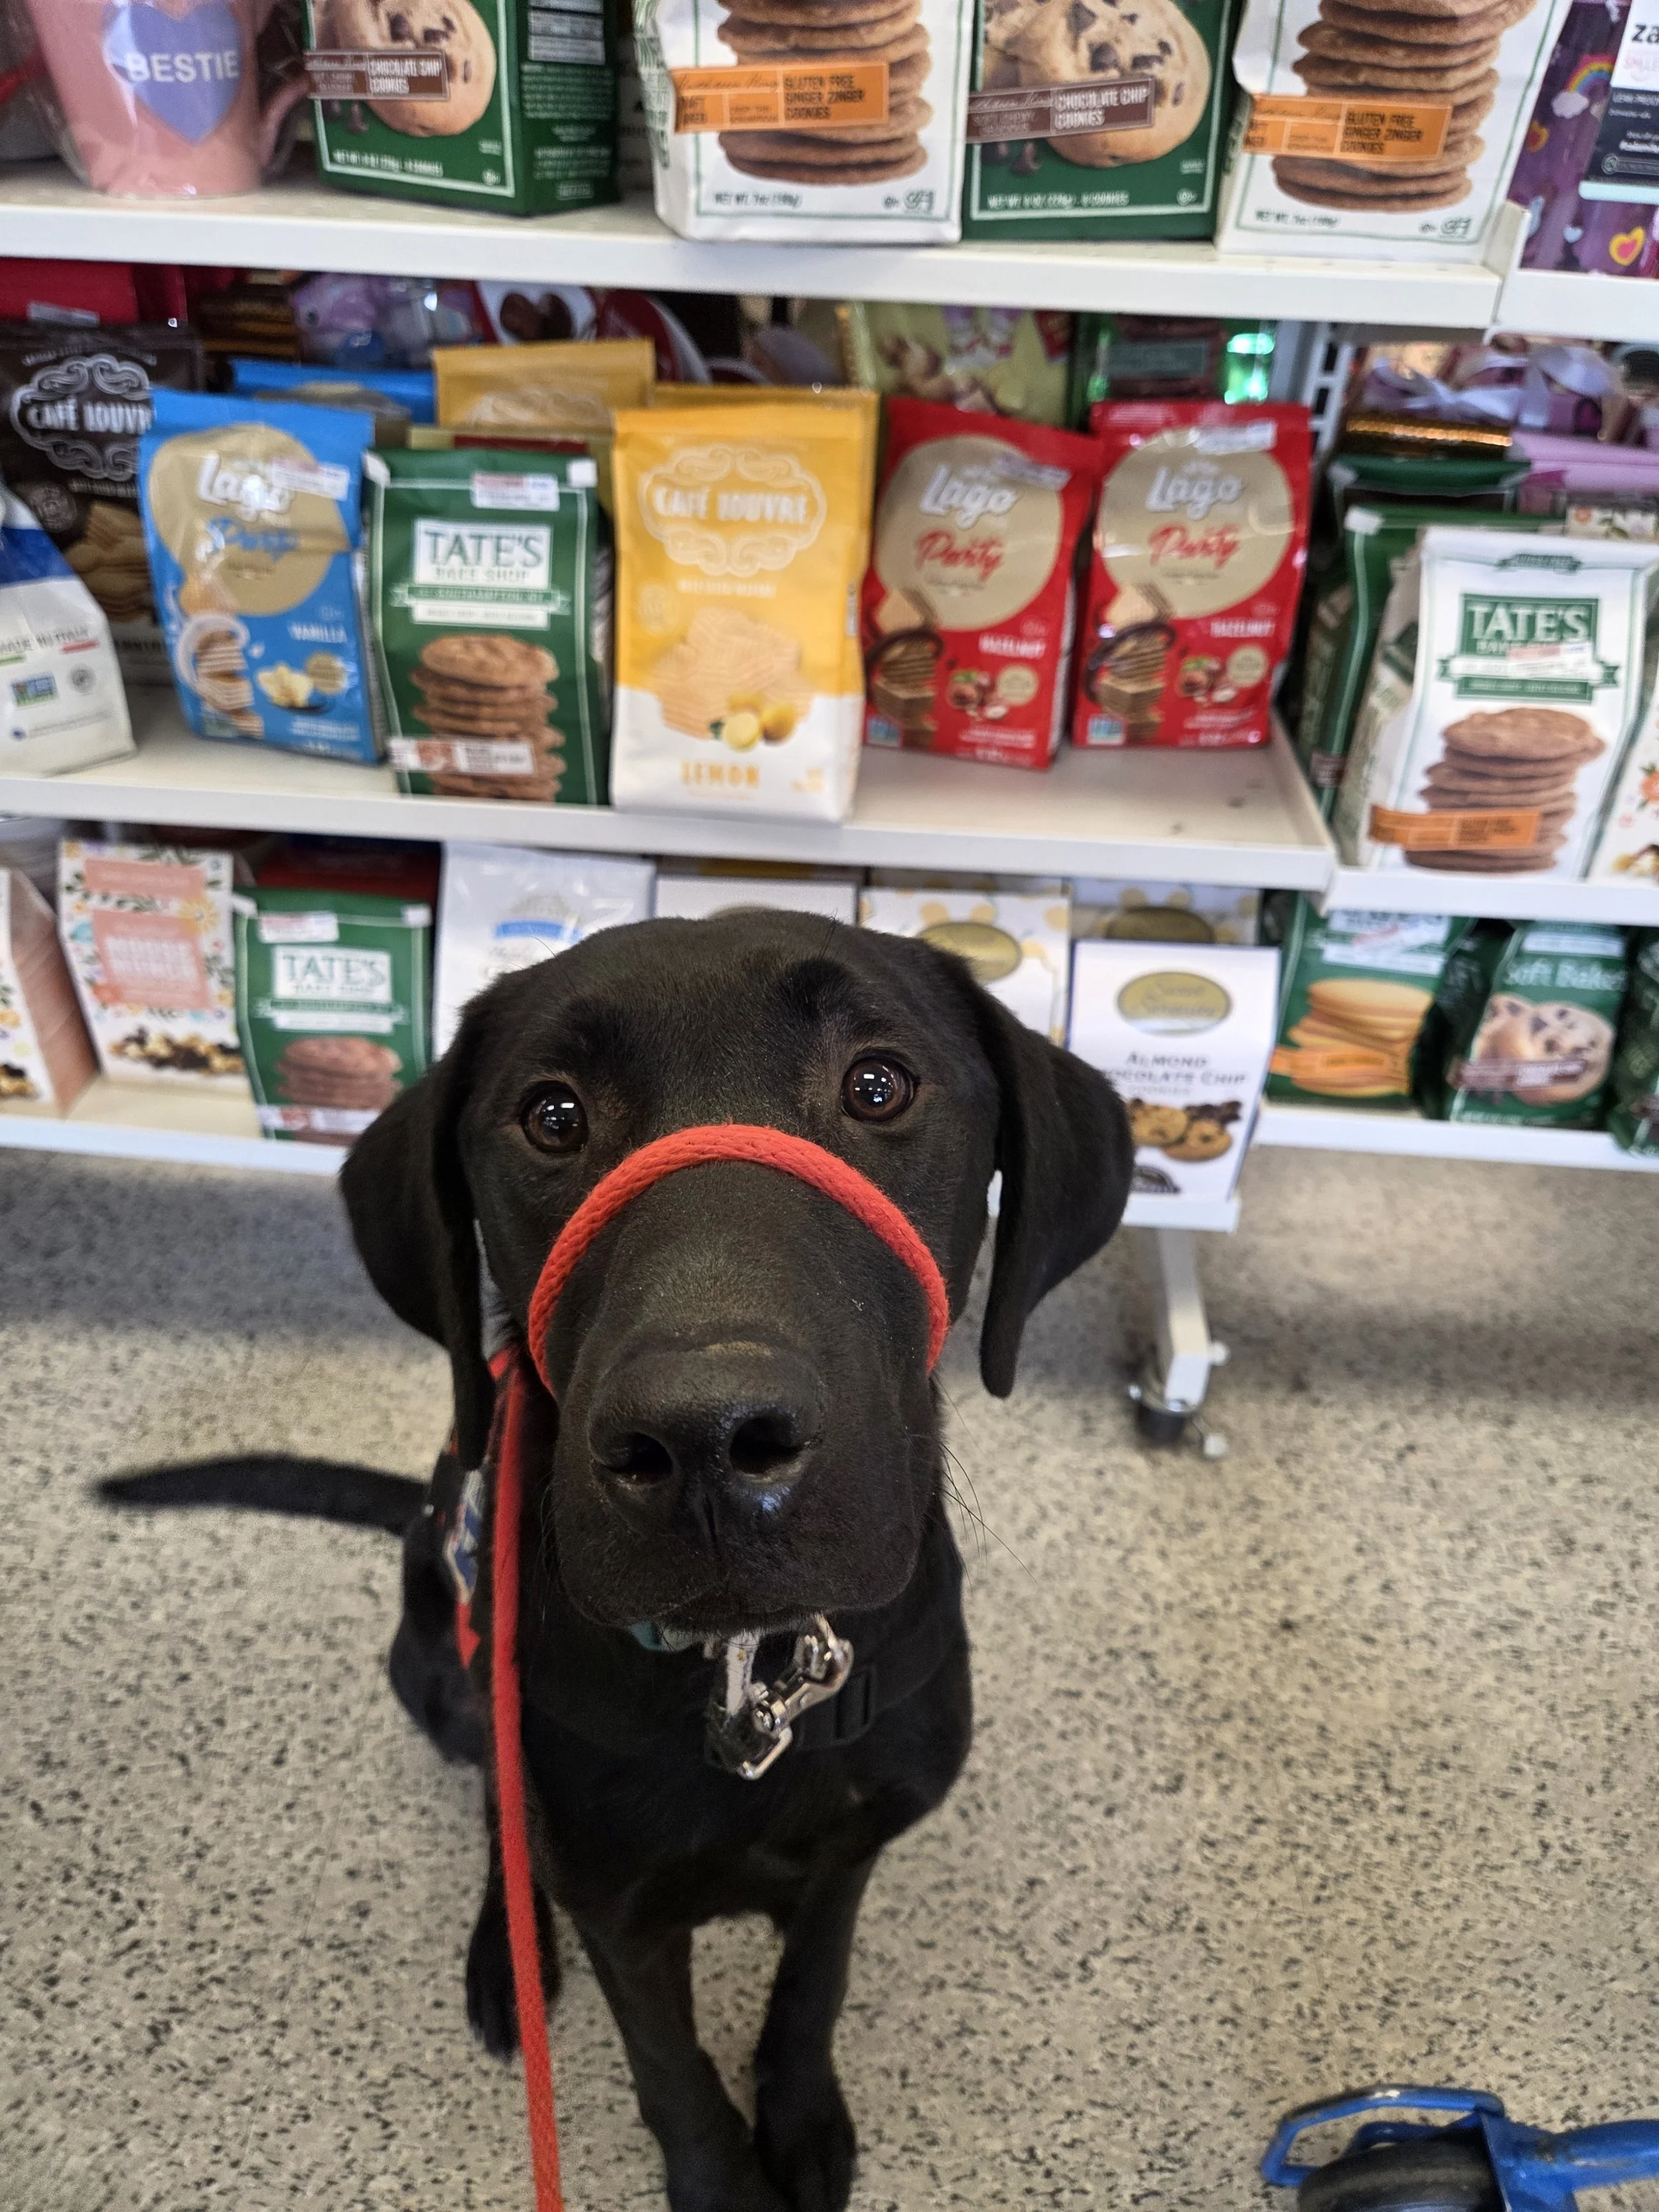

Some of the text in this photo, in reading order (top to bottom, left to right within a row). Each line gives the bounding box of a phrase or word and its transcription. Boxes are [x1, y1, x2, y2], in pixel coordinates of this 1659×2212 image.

[127, 50, 240, 84] BESTIE
[828, 74, 854, 89] FREE
[1055, 89, 1118, 111] CHOCOLATE
[1119, 86, 1150, 105] CHIP
[1054, 107, 1106, 130] COOKIES
[920, 464, 1019, 530] Lago
[1146, 466, 1245, 520] Lago
[425, 530, 543, 569] TATE'S
[915, 528, 1004, 583] Party
[1467, 602, 1589, 643] TATE'S
[282, 954, 387, 987] TATE'S
[1112, 1069, 1196, 1084] OCOLATE
[1127, 1051, 1210, 1069] ALMOND
